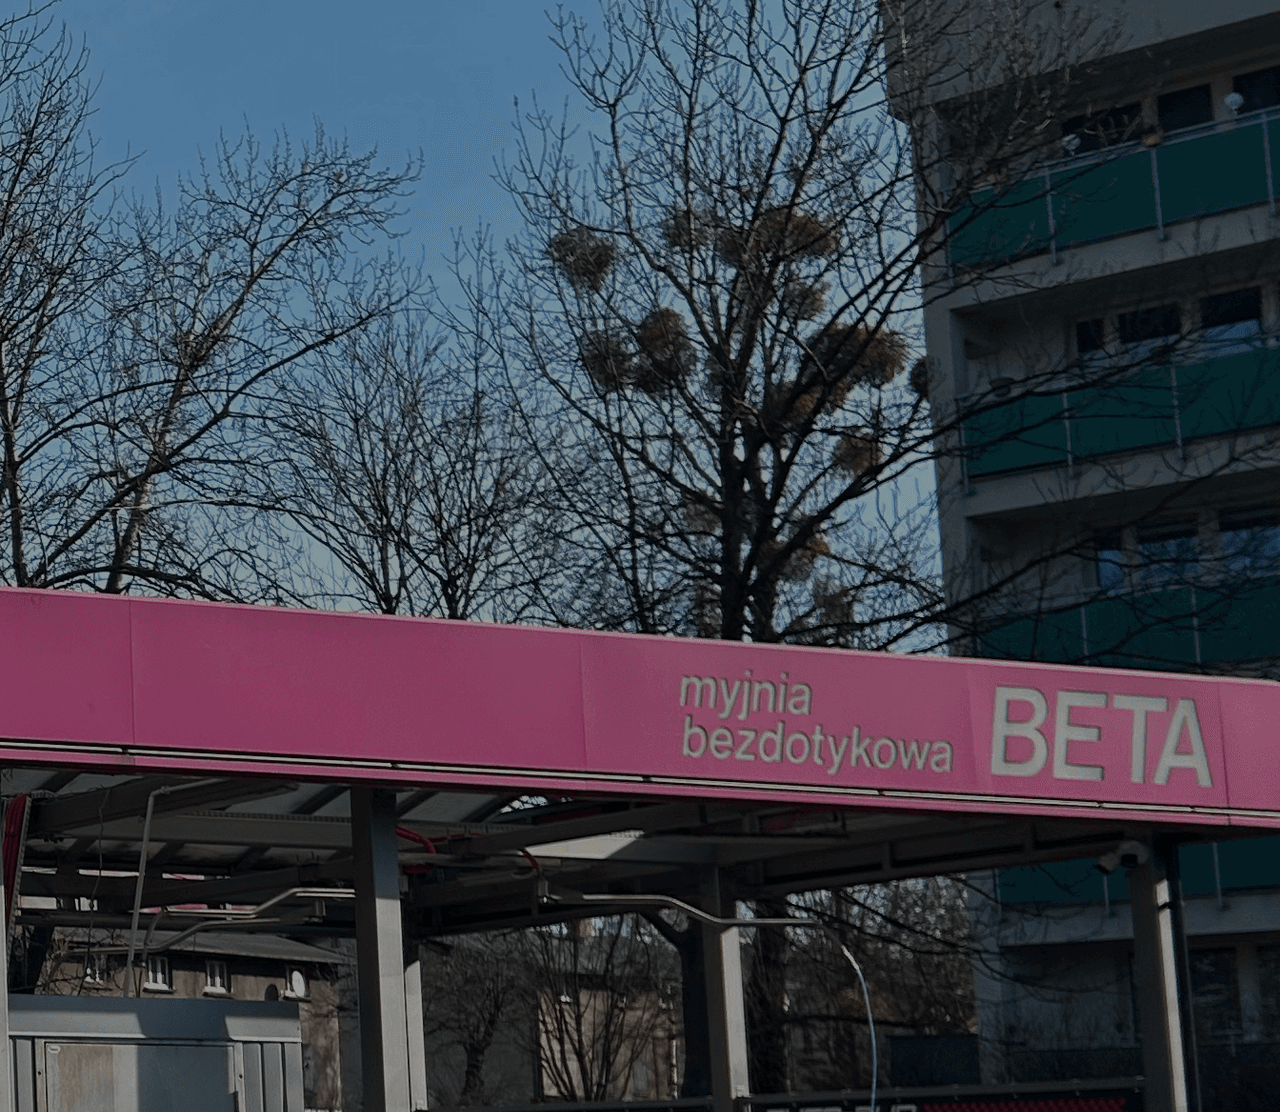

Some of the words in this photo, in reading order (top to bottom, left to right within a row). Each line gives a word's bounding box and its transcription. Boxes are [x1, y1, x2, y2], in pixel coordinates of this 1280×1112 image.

[679, 671, 812, 720] myjnia
[682, 715, 954, 775] bezdotykowa
[991, 686, 1212, 788] BETA
